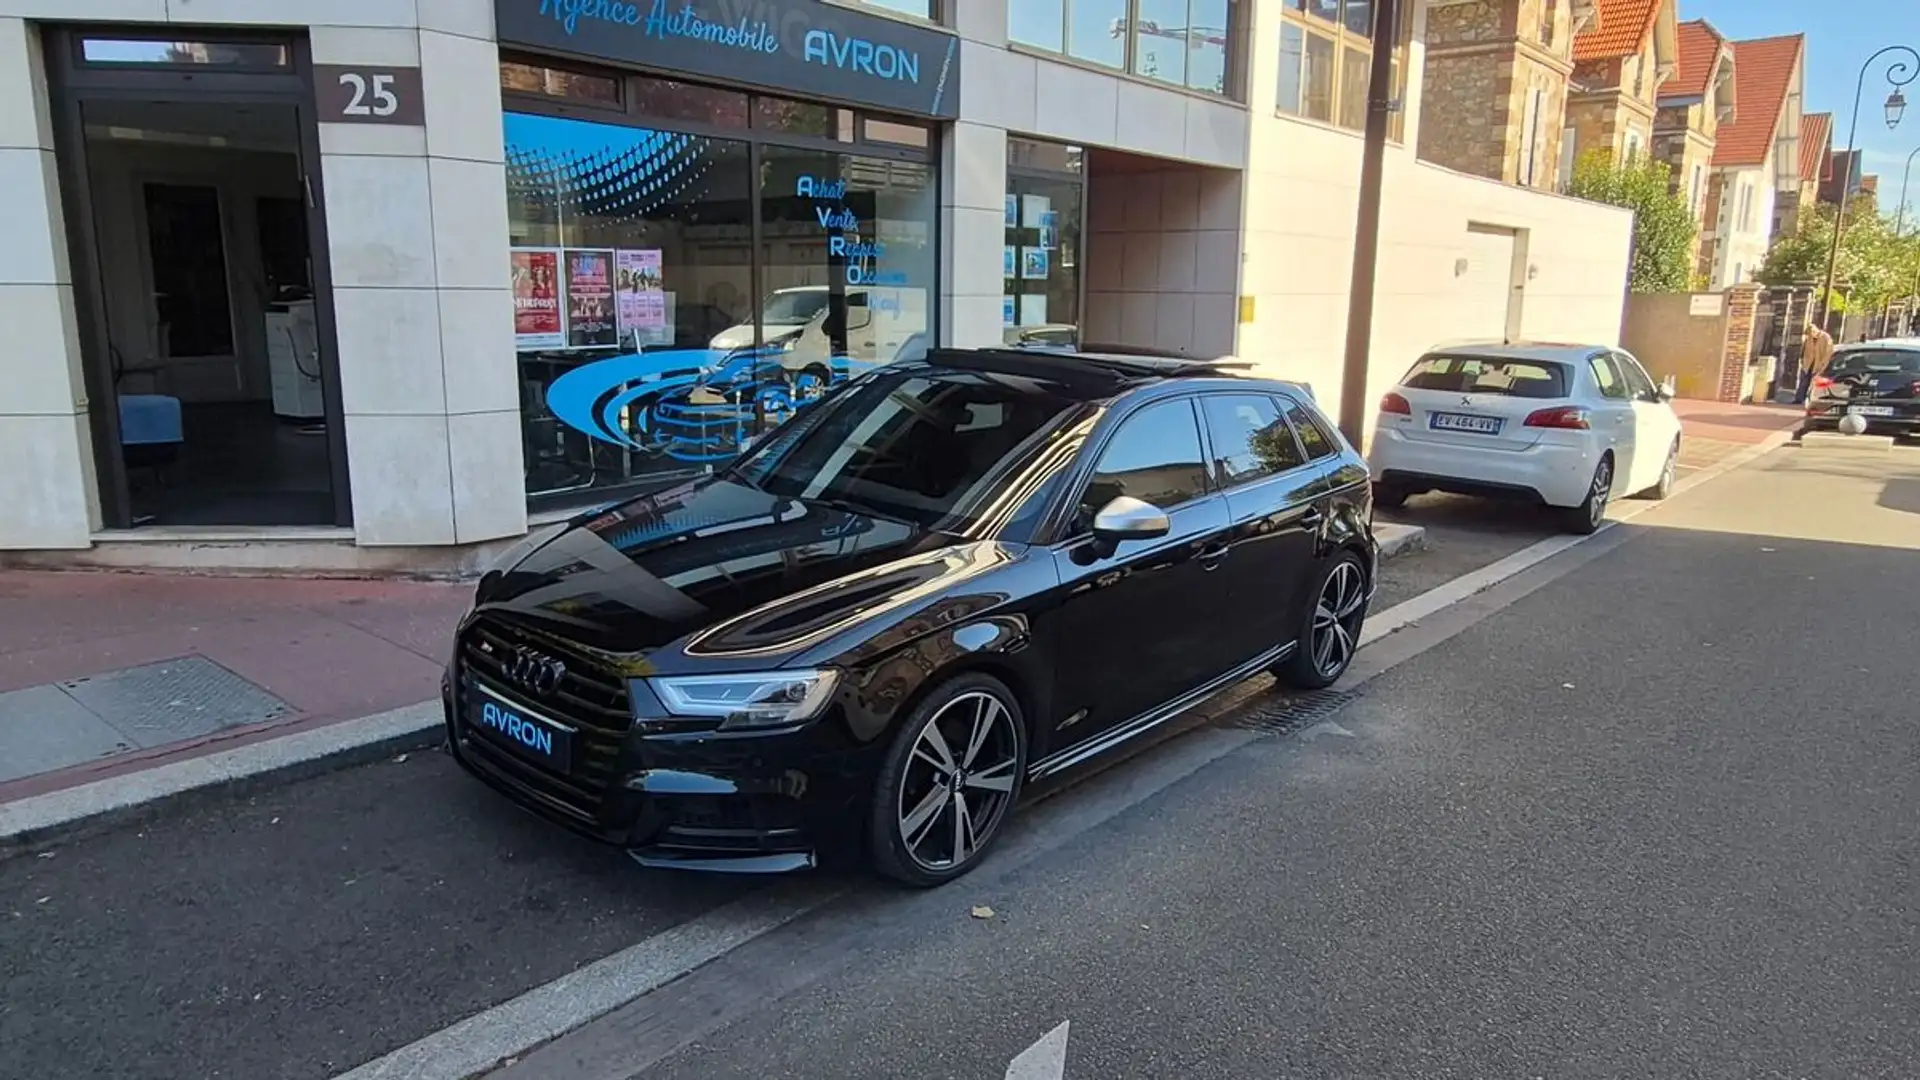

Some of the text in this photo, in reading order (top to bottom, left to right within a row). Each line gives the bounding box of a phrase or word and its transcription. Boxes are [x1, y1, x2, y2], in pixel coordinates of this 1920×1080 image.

[645, 0, 779, 54] Automobile
[804, 30, 919, 84] AVRON
[339, 73, 398, 116] 25
[797, 175, 846, 200] Achat
[483, 702, 552, 755] AVRON
